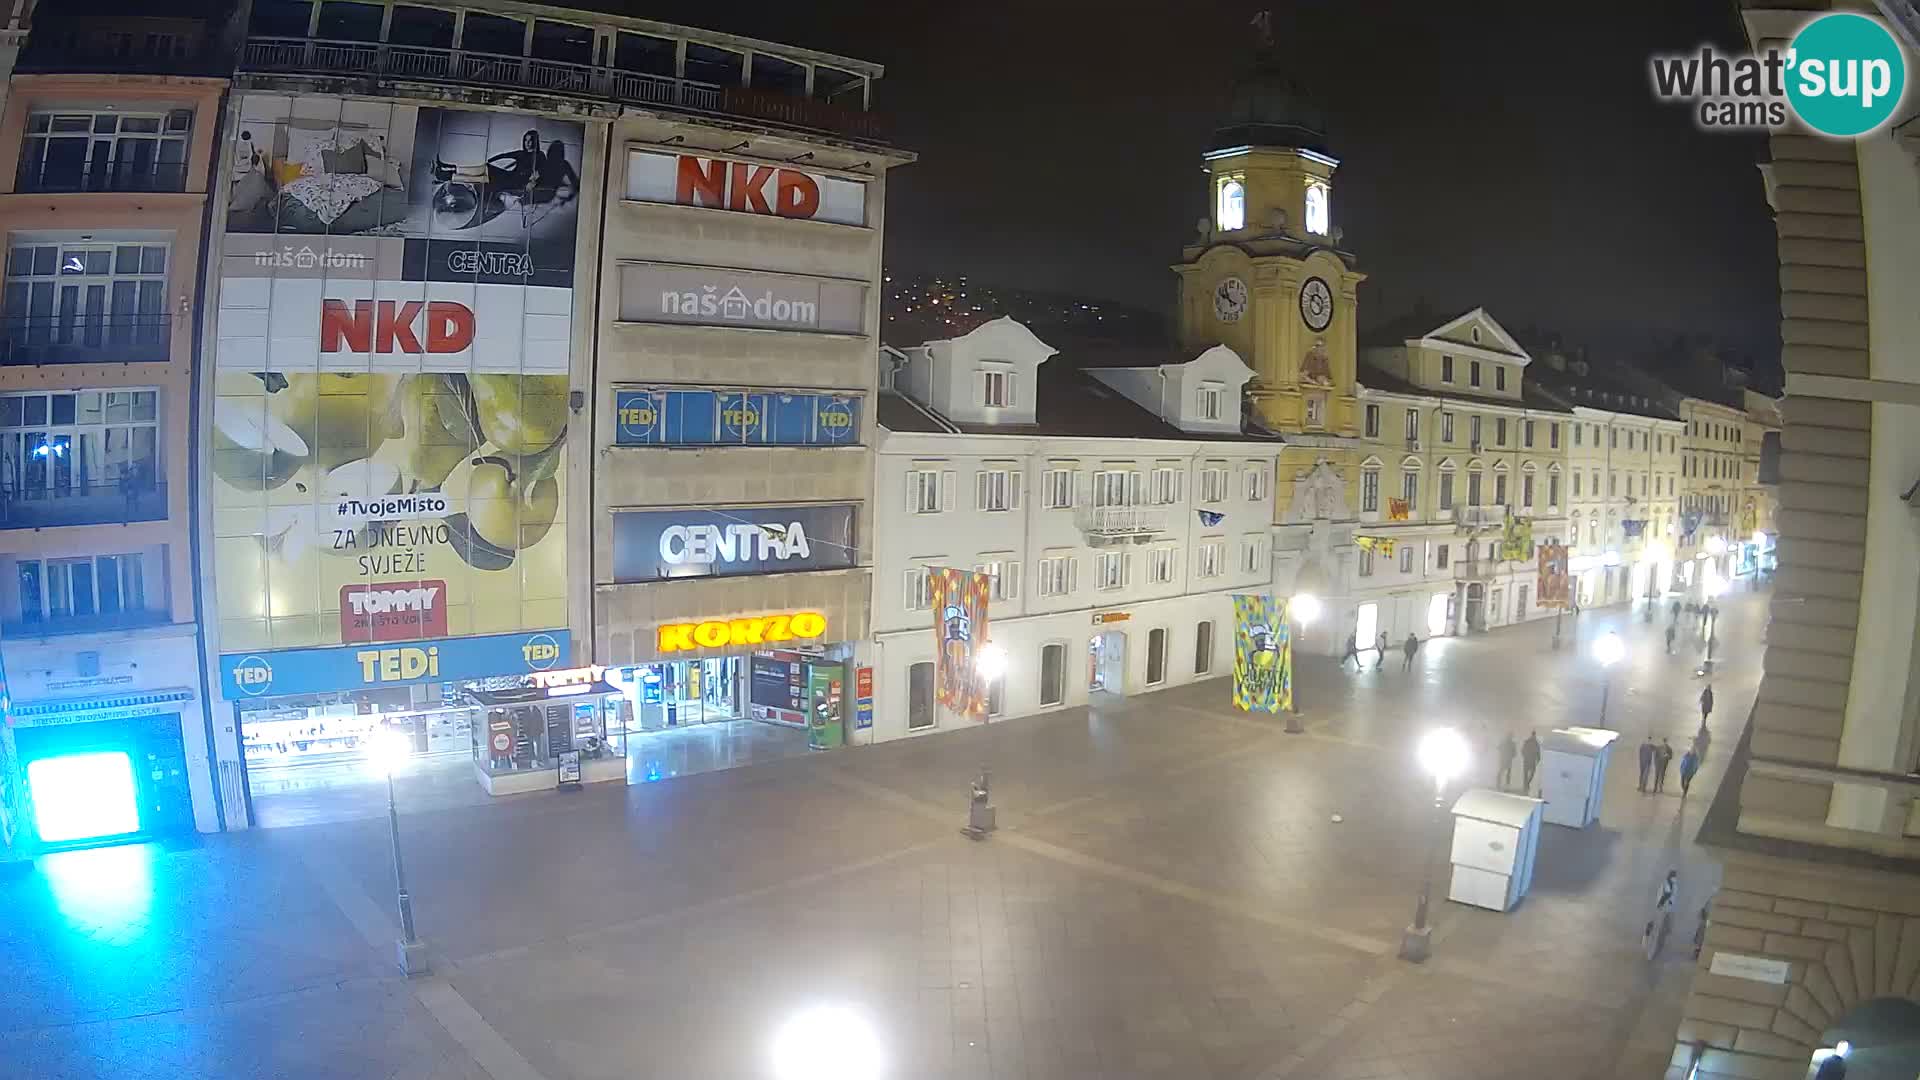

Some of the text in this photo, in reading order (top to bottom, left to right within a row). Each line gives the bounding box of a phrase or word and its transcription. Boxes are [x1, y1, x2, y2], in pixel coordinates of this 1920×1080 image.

[675, 155, 820, 219] NKD
[255, 247, 364, 269] naš dom
[448, 251, 534, 276] CENTRA
[661, 285, 816, 323] naš dom
[320, 299, 476, 353] NKD
[619, 408, 657, 425] TEDi
[723, 409, 759, 426] TEDi
[338, 498, 445, 517] #TvojeMisto
[333, 525, 449, 549] ZA DNEVNO
[659, 522, 810, 564] CENTRA
[359, 548, 426, 576] SVJEŽE
[349, 588, 439, 615] TOMMY
[657, 612, 826, 651] KORZO
[357, 646, 439, 683] TEDi
[522, 643, 560, 661] TEDi
[233, 667, 273, 685] TEDi
